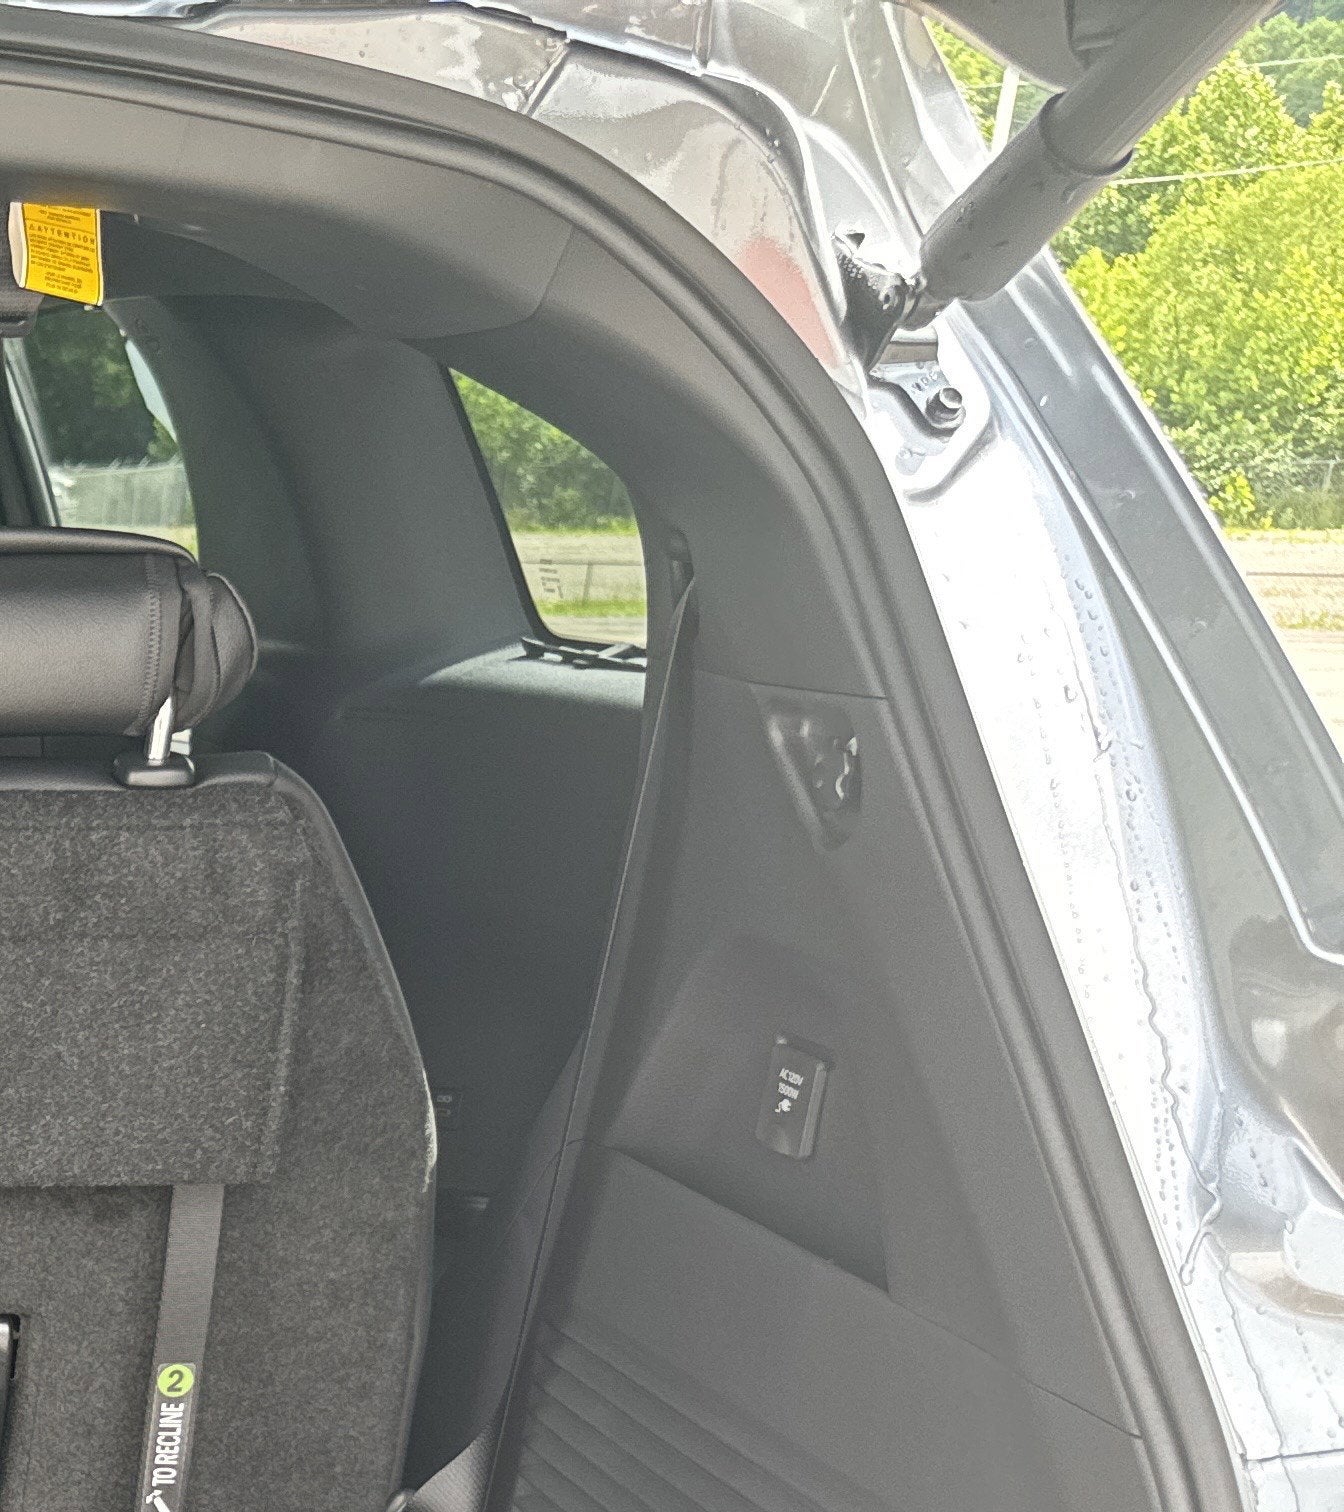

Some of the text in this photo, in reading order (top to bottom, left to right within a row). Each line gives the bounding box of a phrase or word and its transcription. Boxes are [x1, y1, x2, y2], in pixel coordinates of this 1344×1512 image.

[166, 1369, 184, 1393] 2
[152, 1402, 184, 1486] TO RECLINE
